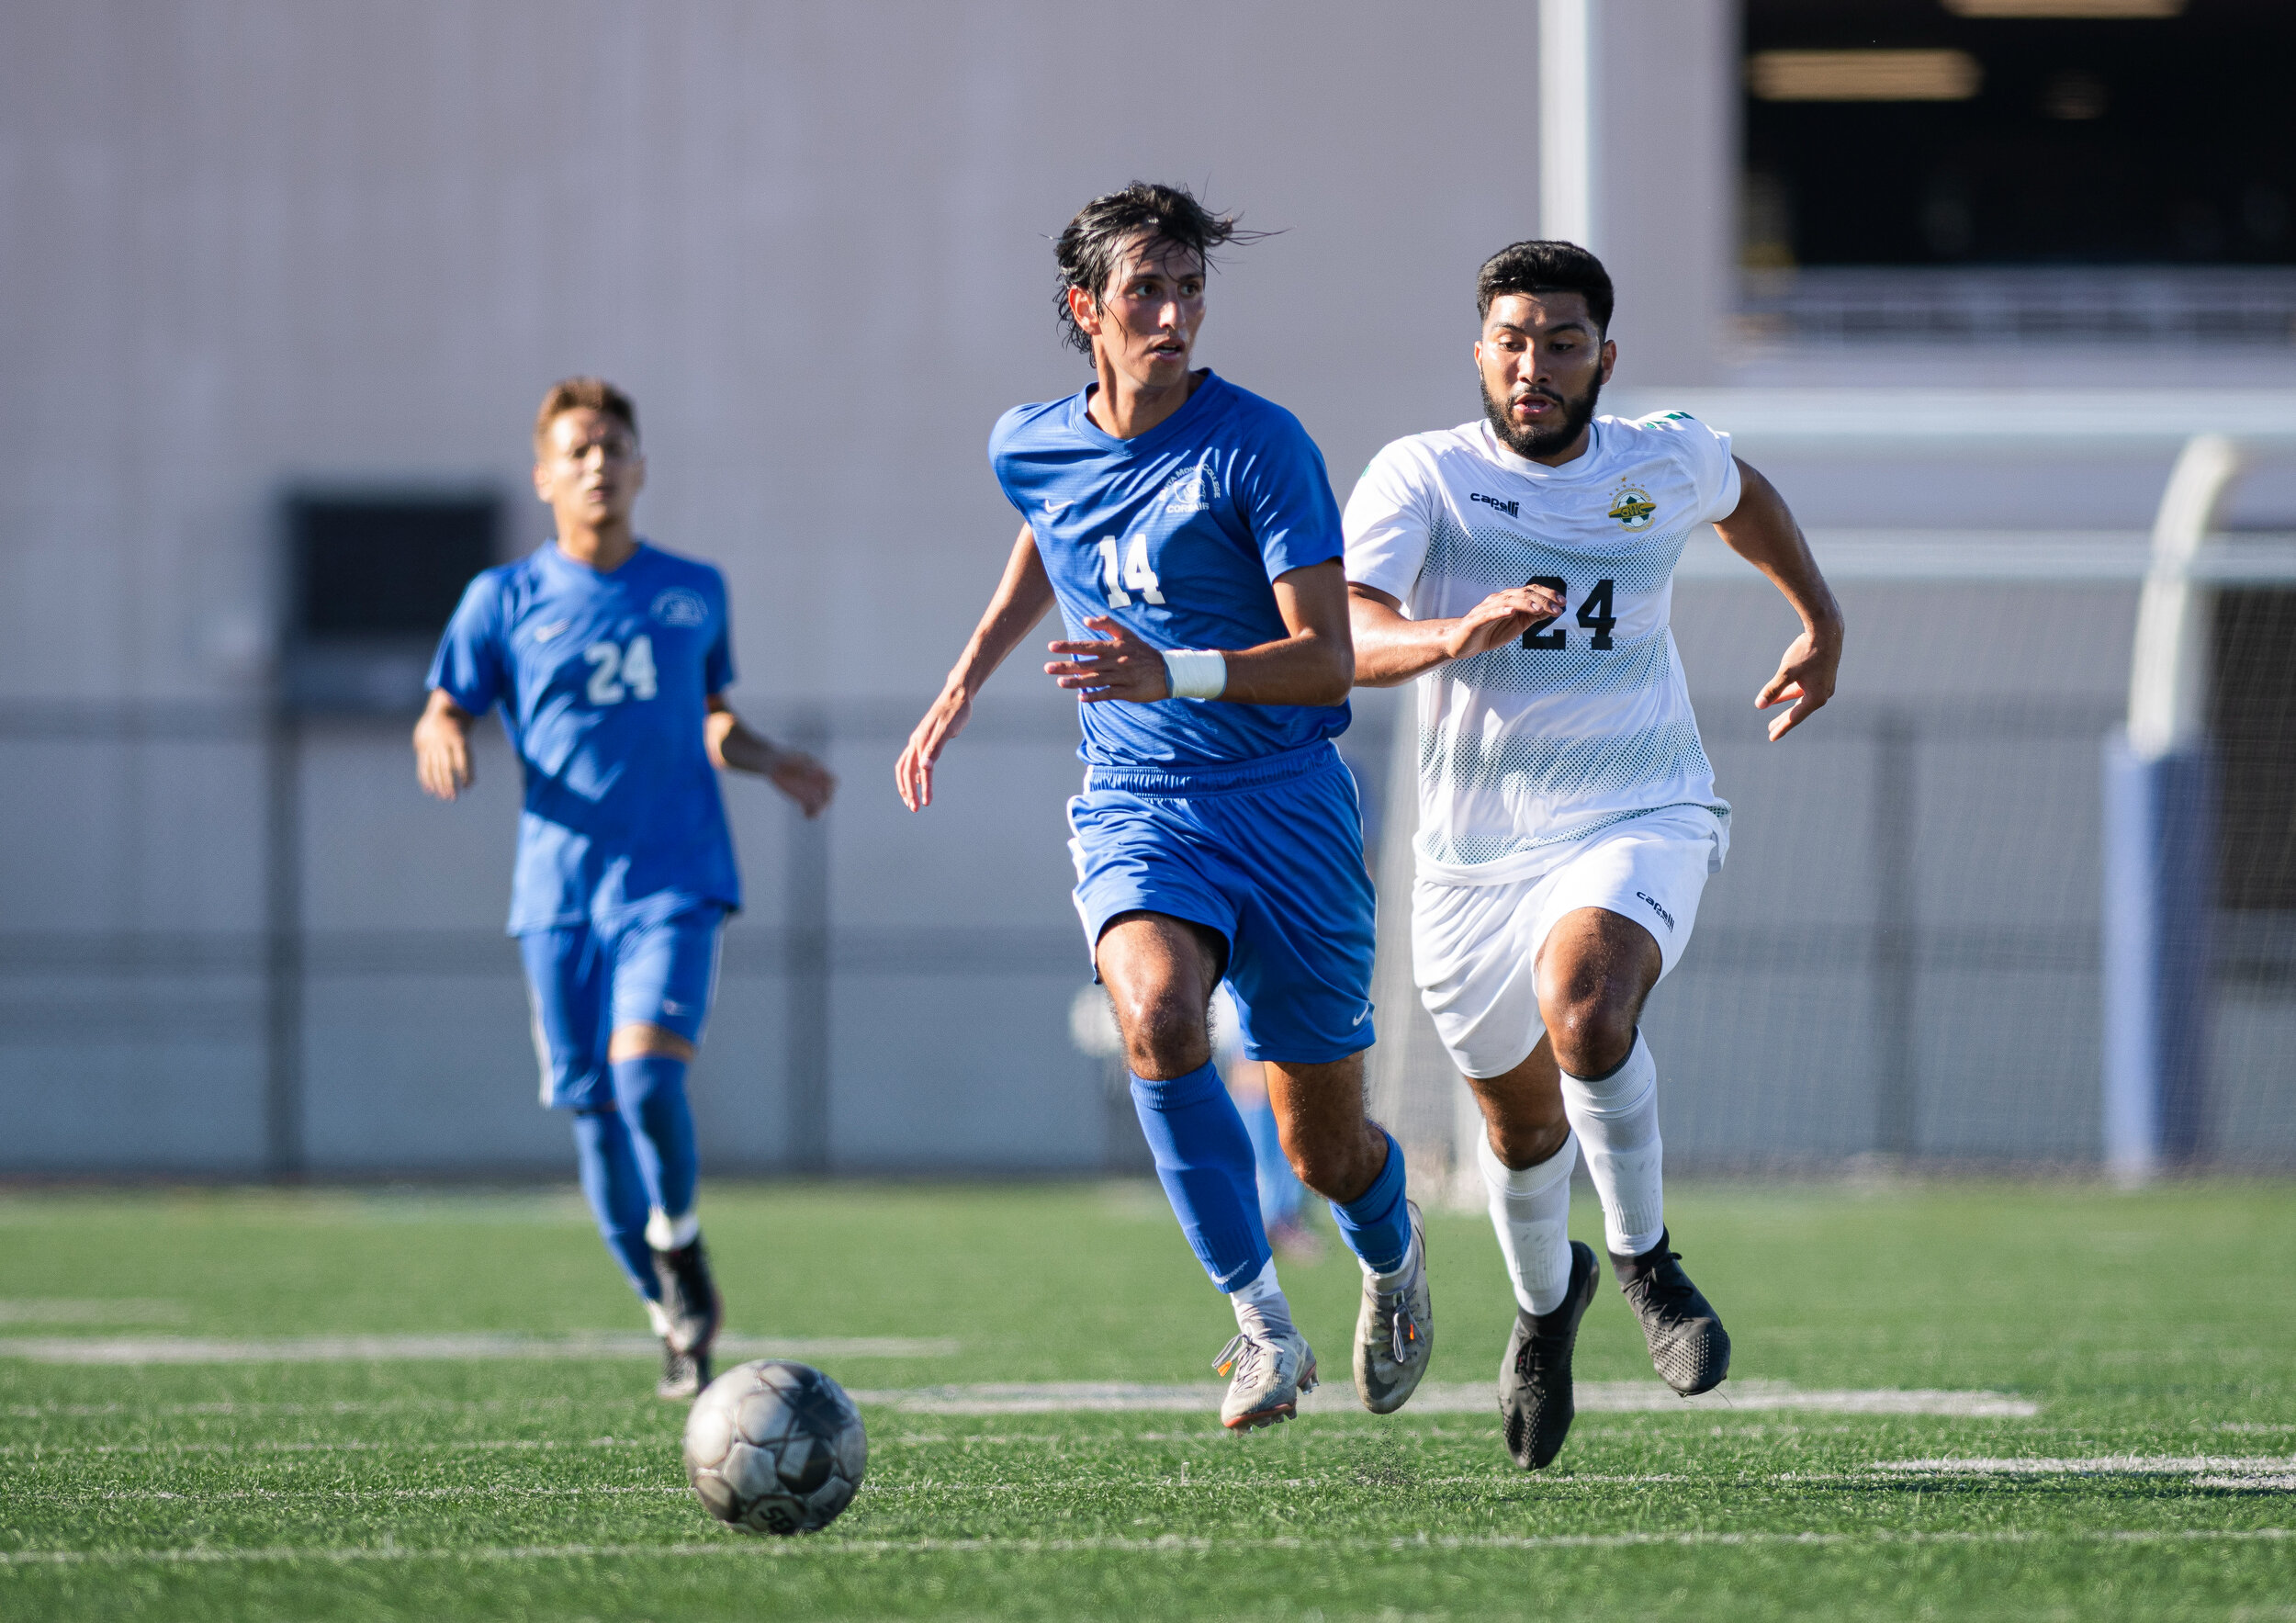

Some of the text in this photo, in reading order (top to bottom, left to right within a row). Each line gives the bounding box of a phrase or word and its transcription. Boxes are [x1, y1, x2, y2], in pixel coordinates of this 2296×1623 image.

[1469, 492, 1520, 517] capelli
[1620, 503, 1647, 517] GWC
[1099, 533, 1166, 610] 14
[1522, 575, 1616, 650] 24
[584, 635, 658, 705] 24
[1636, 891, 1675, 930] capelli
